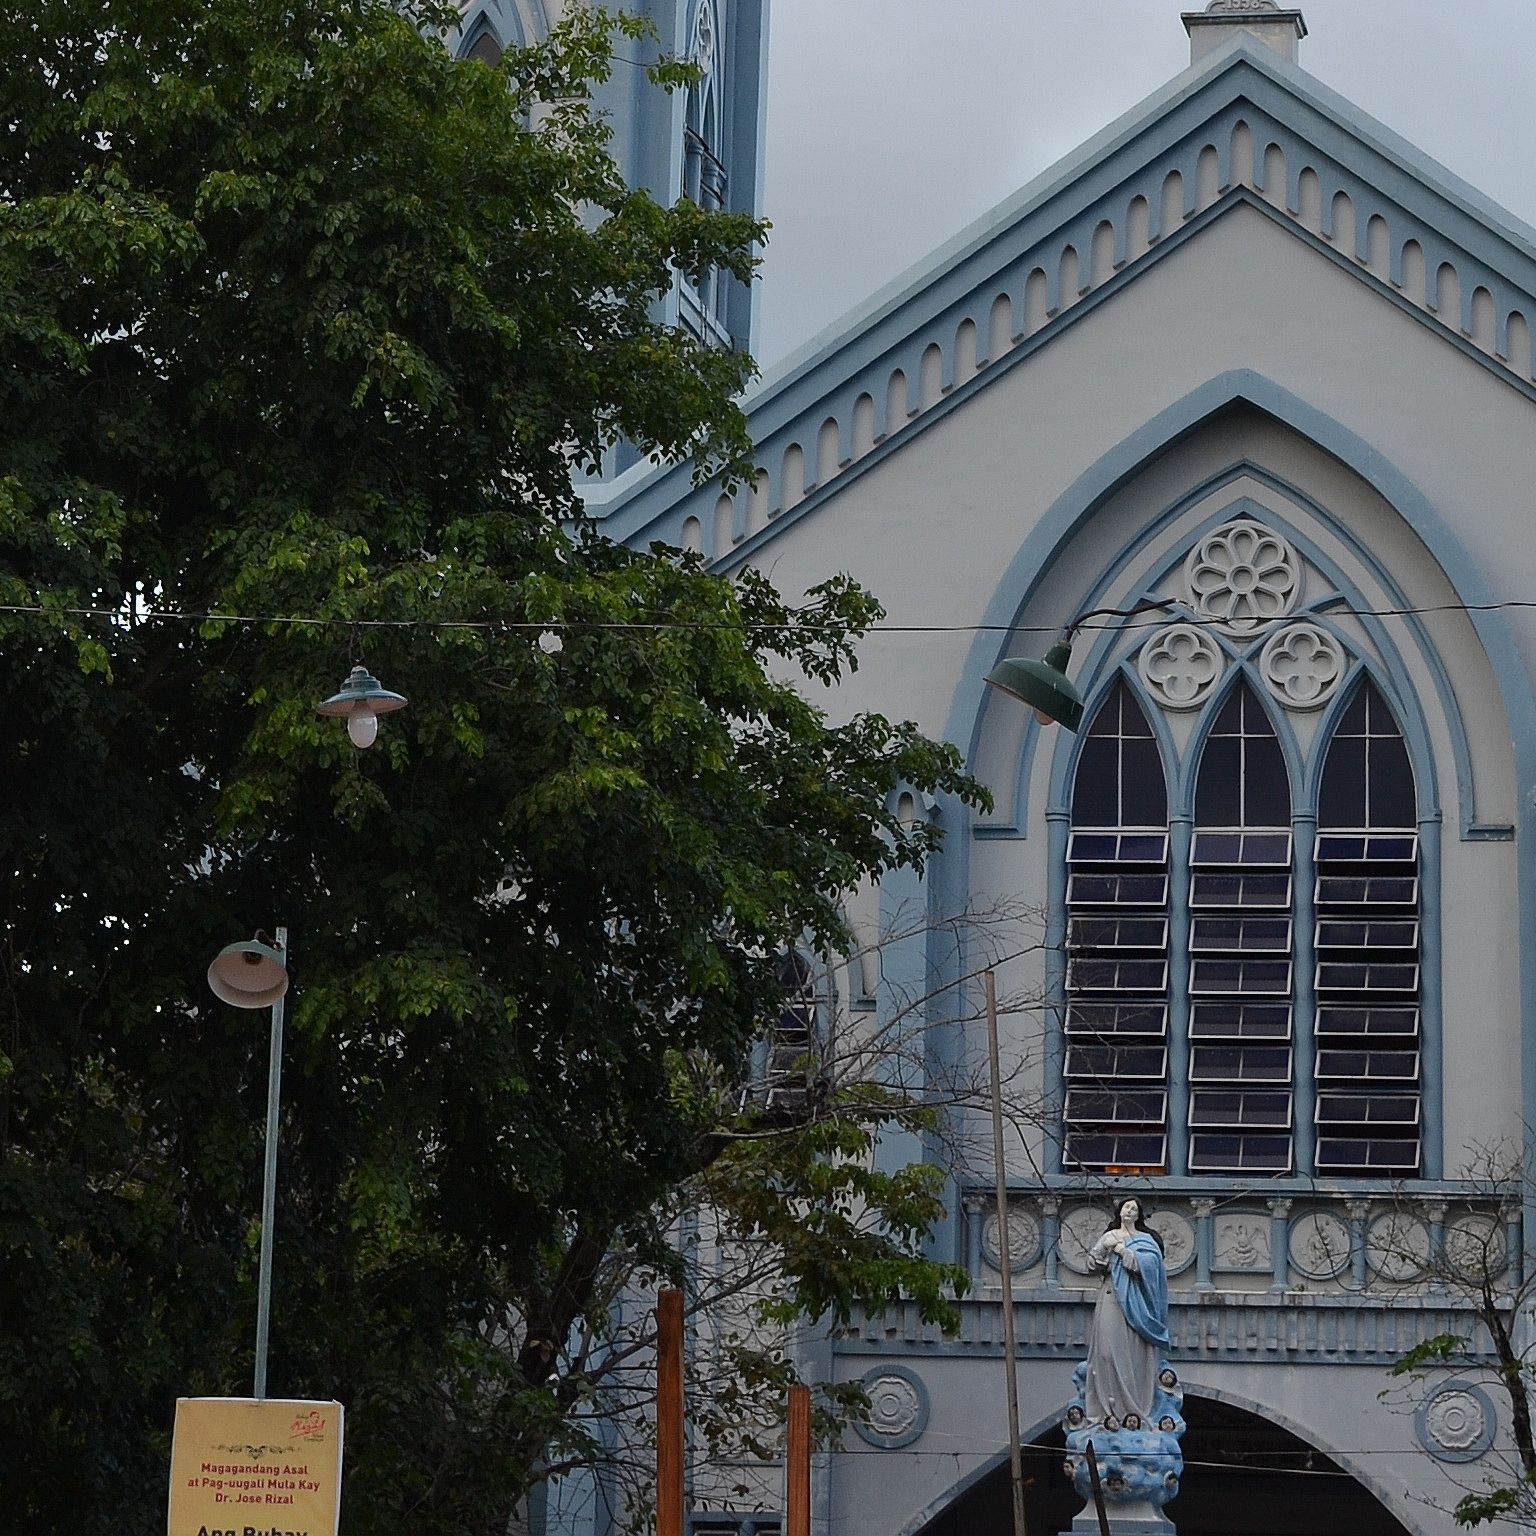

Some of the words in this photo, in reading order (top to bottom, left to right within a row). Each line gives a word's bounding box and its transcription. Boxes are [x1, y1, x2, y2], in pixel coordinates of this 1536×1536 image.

[201, 1463, 280, 1476] Magagandang
[283, 1464, 308, 1475] Asal
[188, 1478, 199, 1488] at
[202, 1478, 264, 1490] Pag-uugali
[268, 1480, 295, 1490] Mula
[298, 1480, 320, 1492] Kay
[215, 1493, 233, 1503] Dr.
[236, 1494, 262, 1504] Jose
[264, 1494, 294, 1504] Rizal
